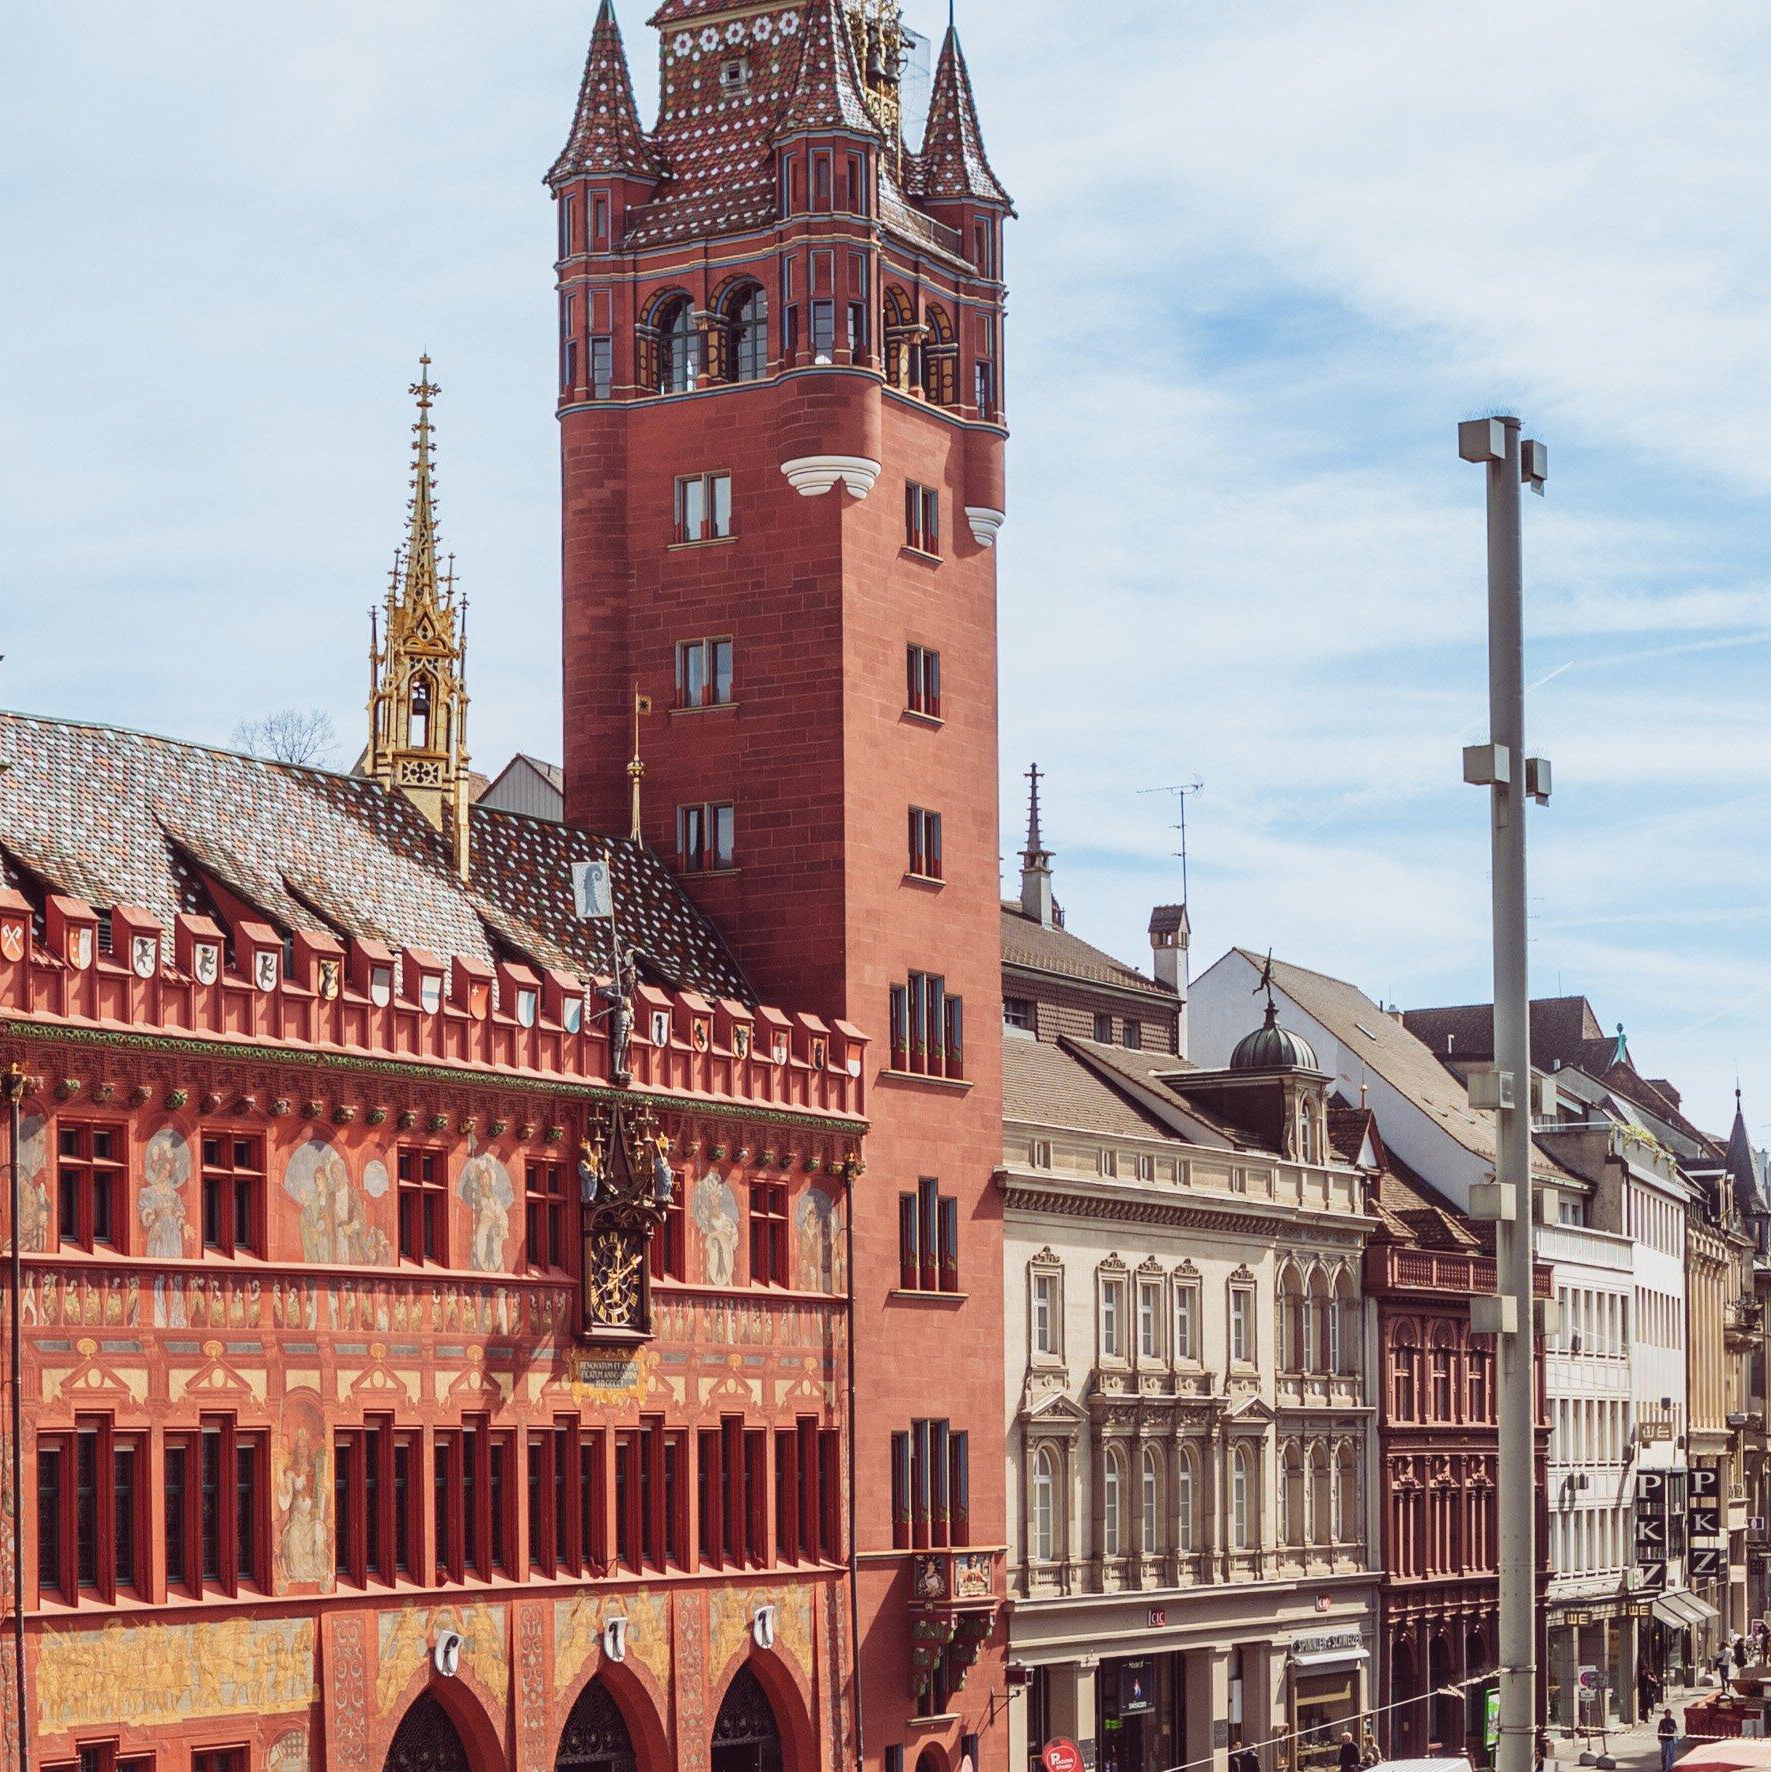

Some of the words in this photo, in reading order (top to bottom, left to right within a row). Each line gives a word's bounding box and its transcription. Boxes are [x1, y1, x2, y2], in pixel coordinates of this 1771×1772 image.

[1642, 1425, 1670, 1440] WE
[1691, 1470, 1717, 1575] PKZ
[1629, 1605, 1649, 1616] WE
[1567, 1613, 1589, 1625] WE
